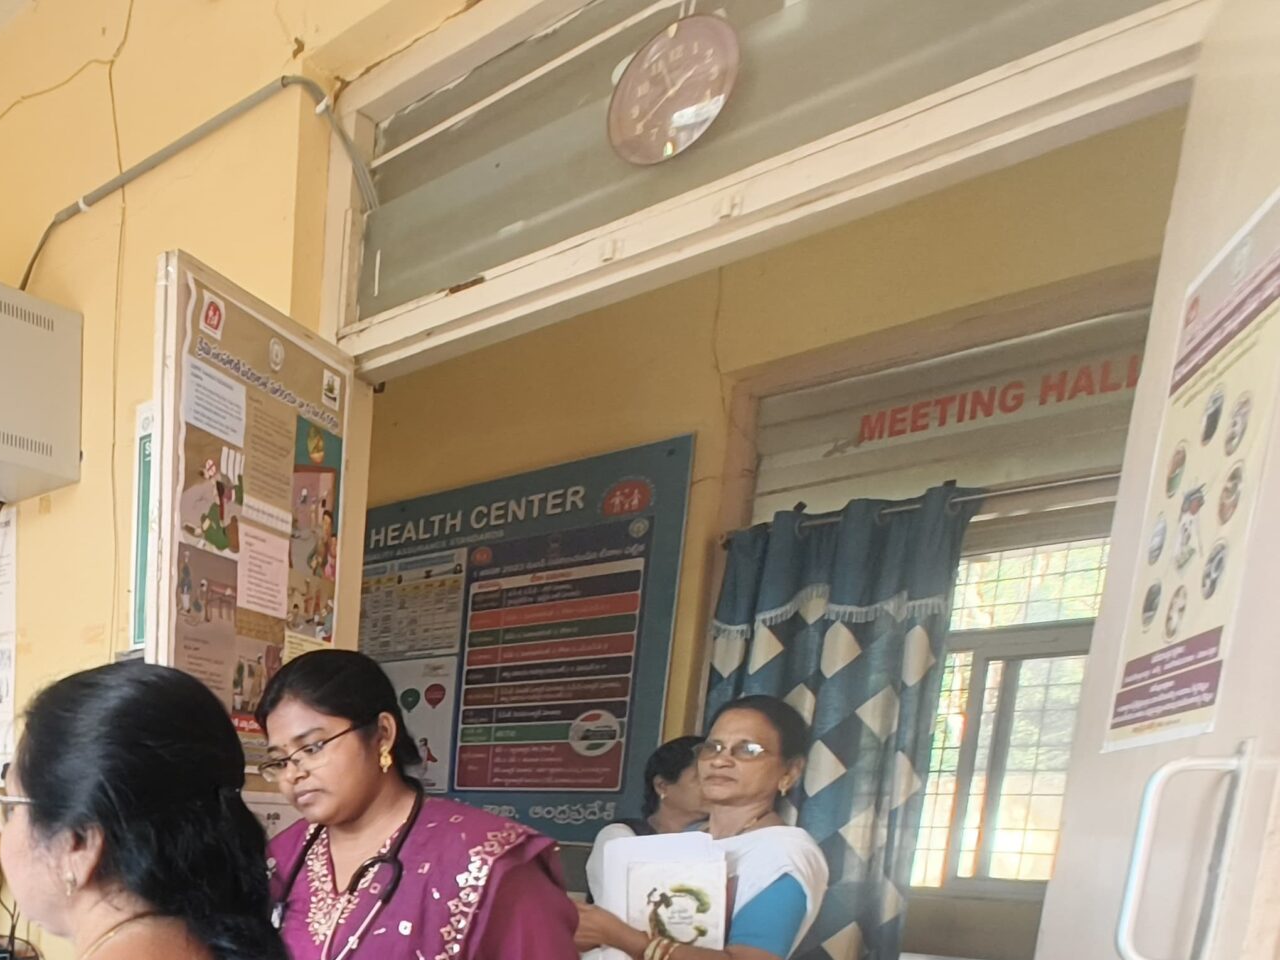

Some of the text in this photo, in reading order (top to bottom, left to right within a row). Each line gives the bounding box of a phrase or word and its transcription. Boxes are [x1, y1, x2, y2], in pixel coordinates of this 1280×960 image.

[857, 355, 1139, 444] MEETING HALL
[369, 485, 586, 549] HEALTH CENTER
